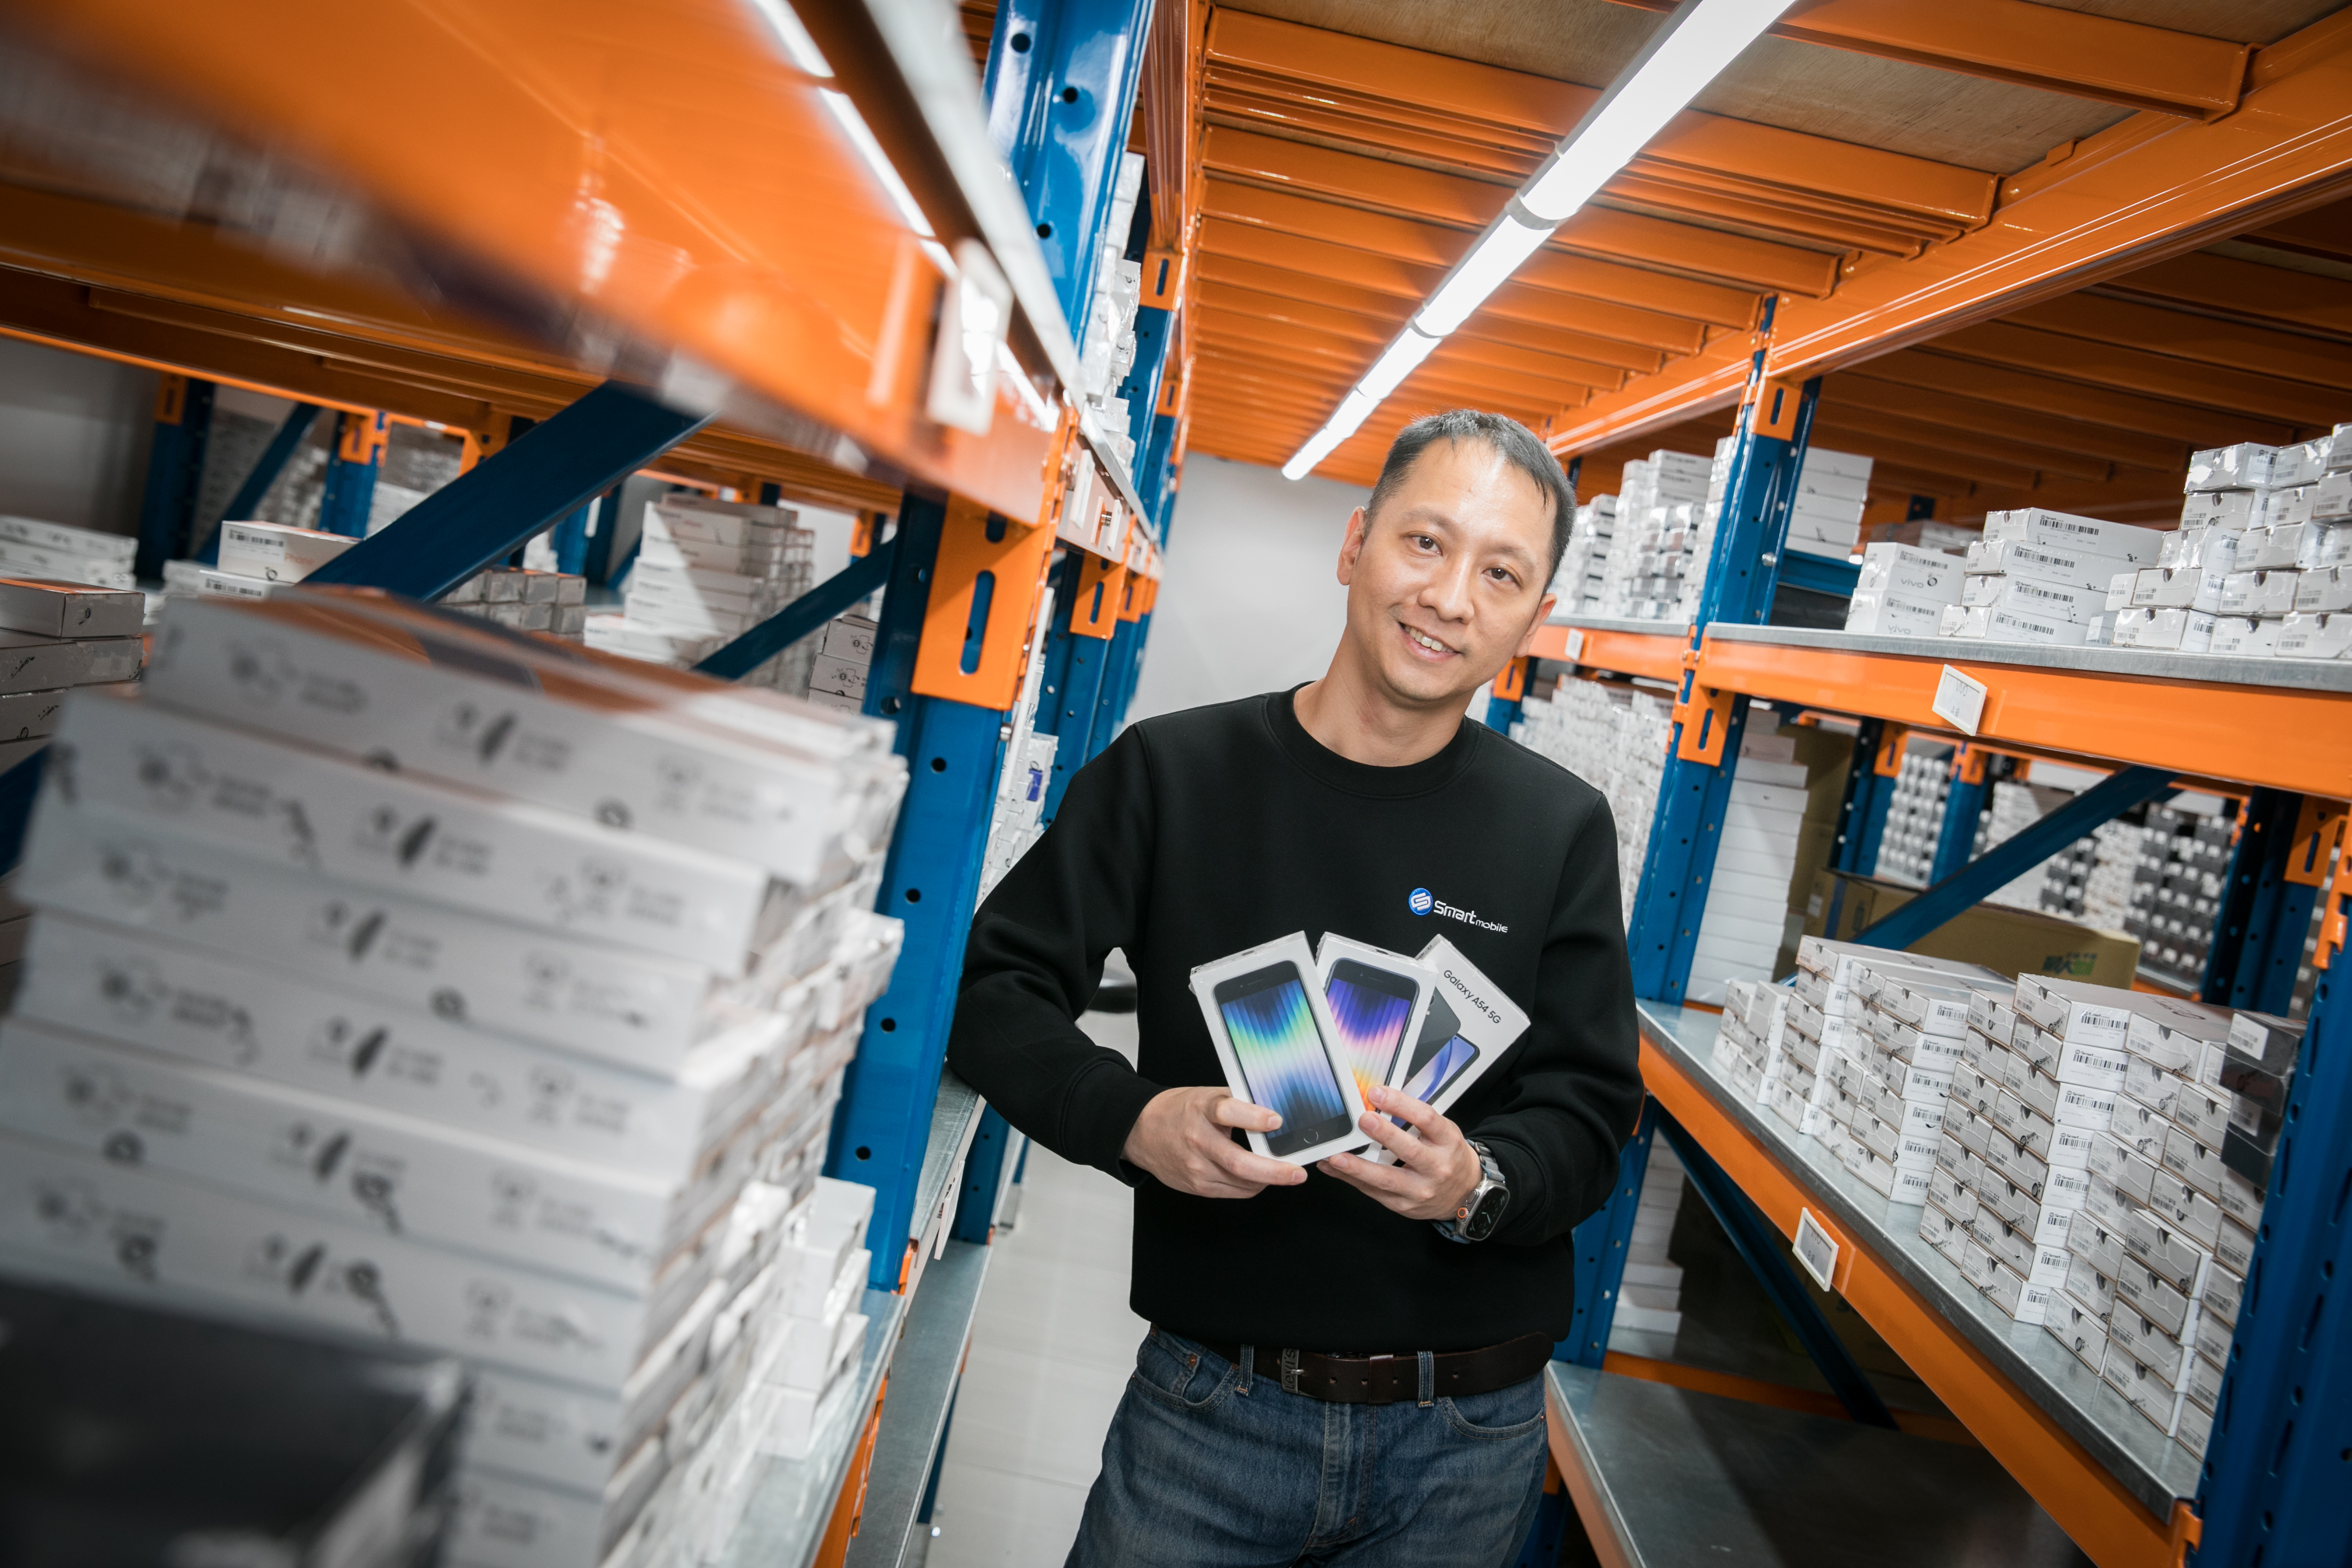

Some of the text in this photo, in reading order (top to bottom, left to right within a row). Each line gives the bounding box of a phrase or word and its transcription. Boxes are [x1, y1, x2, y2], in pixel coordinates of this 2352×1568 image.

[1900, 578, 1924, 588] vivo
[1888, 624, 1911, 635] vivo
[1434, 900, 1508, 933] Smart mobile
[1443, 970, 1501, 1024] Galaxy A54 5G
